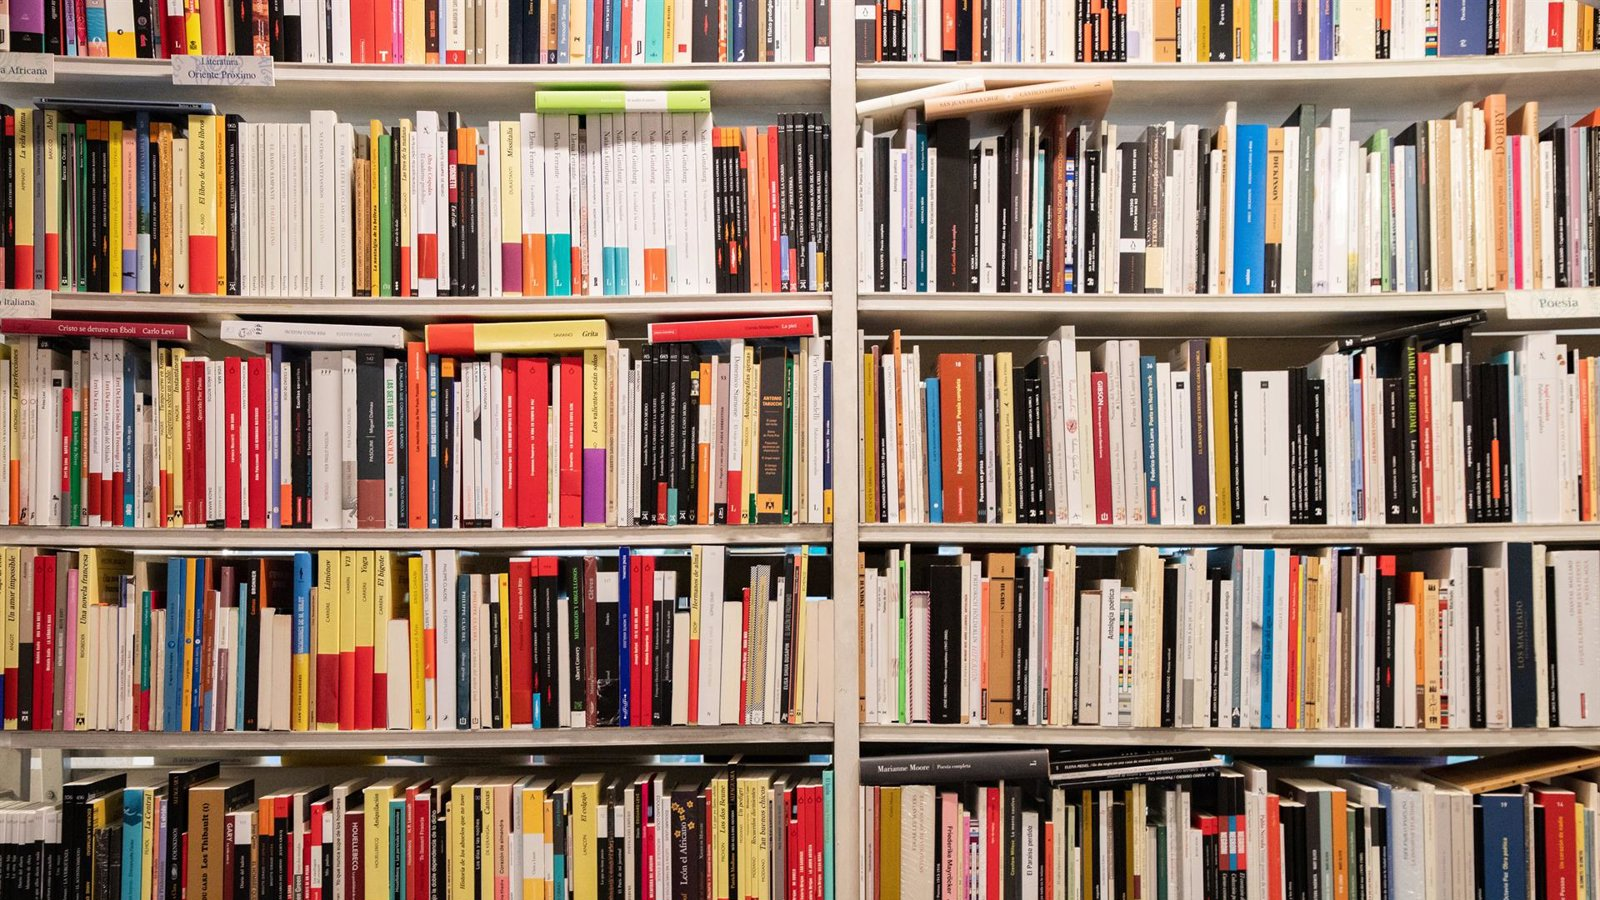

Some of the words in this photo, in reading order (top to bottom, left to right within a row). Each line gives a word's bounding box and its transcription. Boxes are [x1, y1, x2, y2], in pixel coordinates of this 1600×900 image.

[8, 65, 48, 75] Africana
[187, 70, 221, 79] Oriente
[221, 70, 257, 79] Próximo
[46, 114, 54, 130] Abel
[528, 131, 537, 150] Elena
[553, 132, 561, 150] Elena
[1495, 110, 1505, 155] DOBRY
[506, 127, 514, 157] Missitalia
[20, 150, 26, 159] La
[528, 152, 537, 177] Ferrante
[553, 152, 561, 178] Ferrante
[199, 171, 205, 180] de
[1272, 156, 1280, 201] DICKINSON
[4, 297, 35, 307] Italiana
[58, 324, 78, 333] Cristo
[87, 325, 109, 334] detuvo
[119, 324, 137, 334] Éboli
[142, 327, 160, 335] Carlo
[161, 327, 175, 335] Levi
[581, 330, 599, 338] Grita
[1408, 347, 1417, 371] JAIME
[386, 379, 395, 389] LAS
[1408, 373, 1416, 388] GIL
[386, 390, 395, 404] SIETE
[1408, 389, 1416, 401] DE
[386, 405, 395, 420] VIDAS
[1408, 403, 1416, 433] BIEDMA
[386, 429, 395, 465] PASOLINI
[361, 556, 369, 573] Yoga
[693, 569, 699, 577] de
[1107, 589, 1115, 611] poética
[8, 611, 15, 622] Un
[1107, 612, 1116, 640] Antología
[1516, 601, 1524, 650] MACHADO
[1517, 652, 1525, 669] LOS
[877, 764, 909, 774] Marianne
[909, 763, 930, 772] Moore
[581, 792, 589, 814] colgajo
[144, 822, 151, 830] La
[201, 814, 209, 852] Thibault
[678, 822, 688, 855] Africano
[946, 826, 954, 858] Friederike
[679, 865, 688, 885] León
[946, 859, 954, 895] Mayröcker
